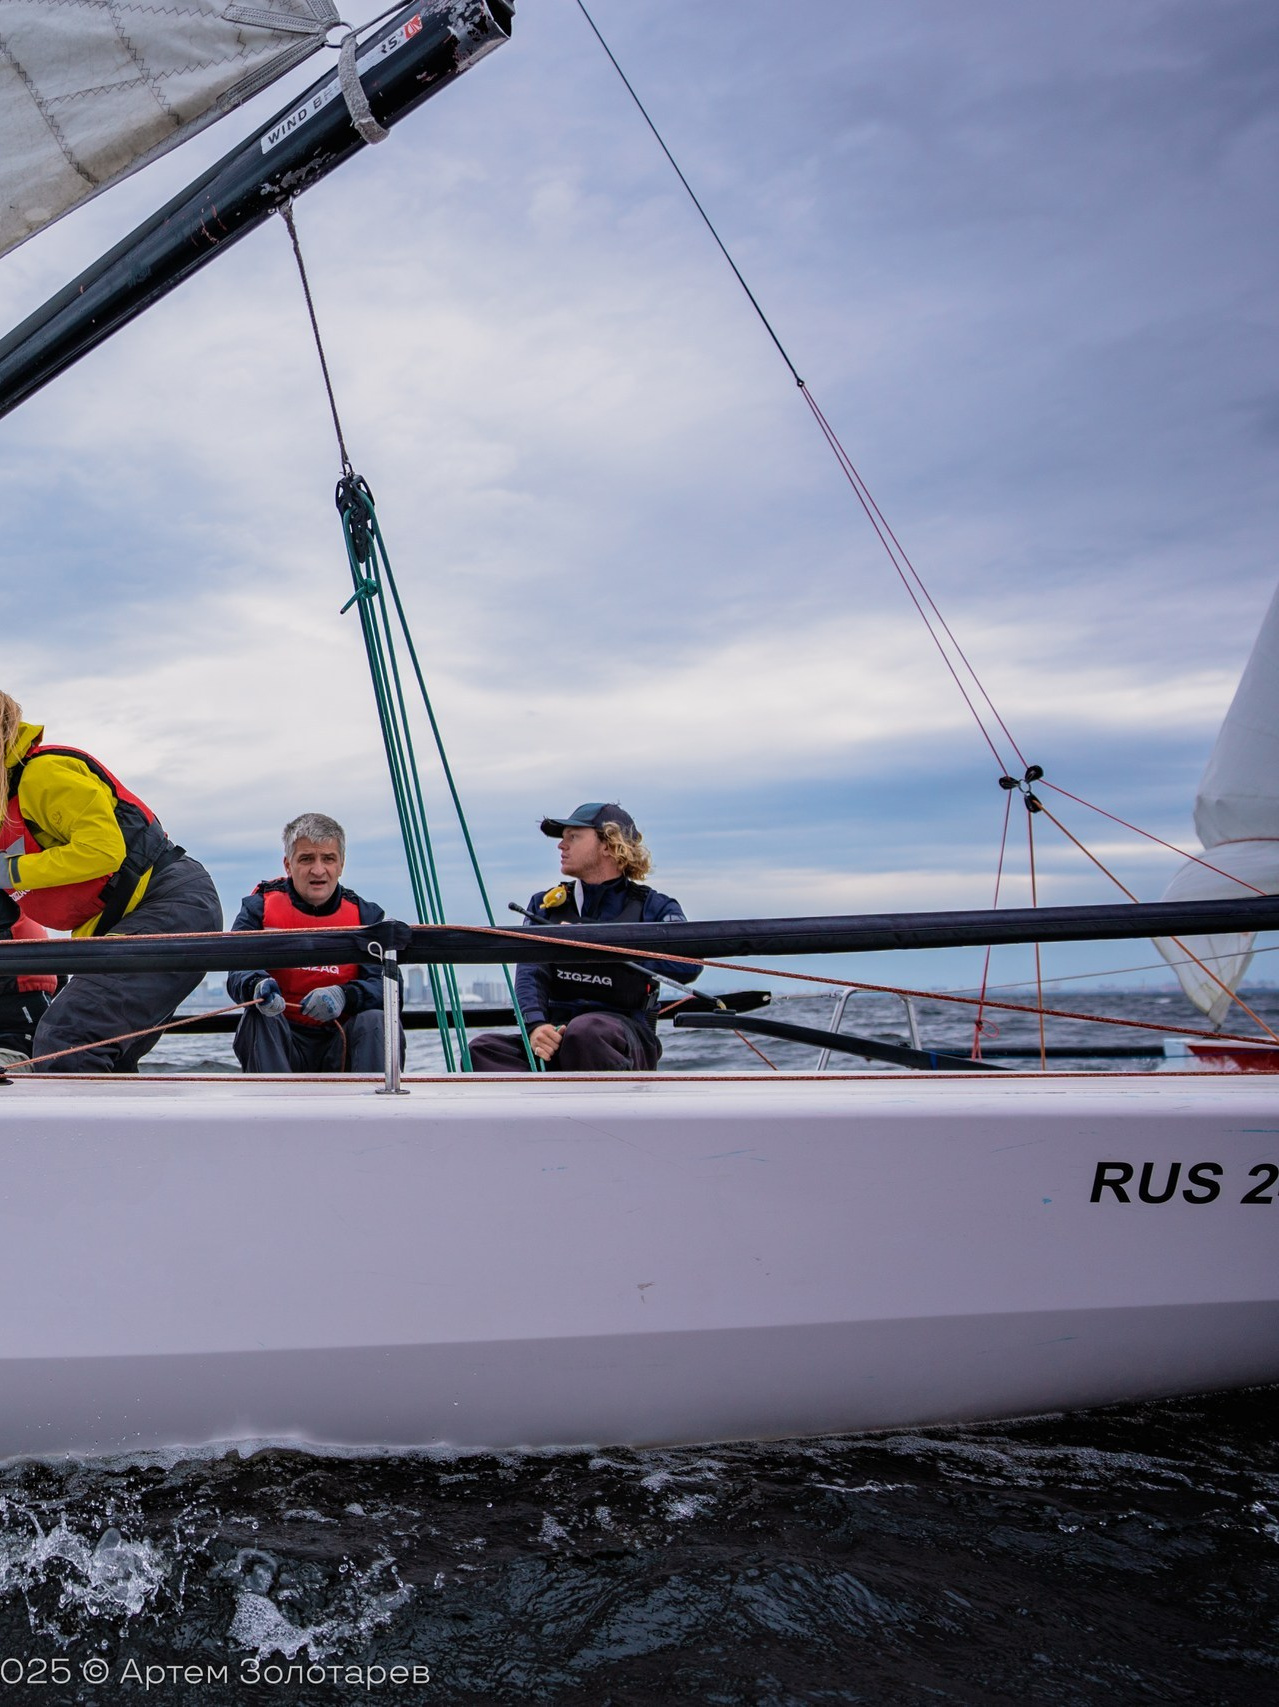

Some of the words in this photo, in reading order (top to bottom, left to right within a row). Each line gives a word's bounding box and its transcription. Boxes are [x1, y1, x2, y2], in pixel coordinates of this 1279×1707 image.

[267, 109, 307, 144] WIND
[556, 969, 613, 987] ZIGZAG
[1089, 1161, 1223, 1204] RUS
[1240, 1163, 1279, 1204] 2
